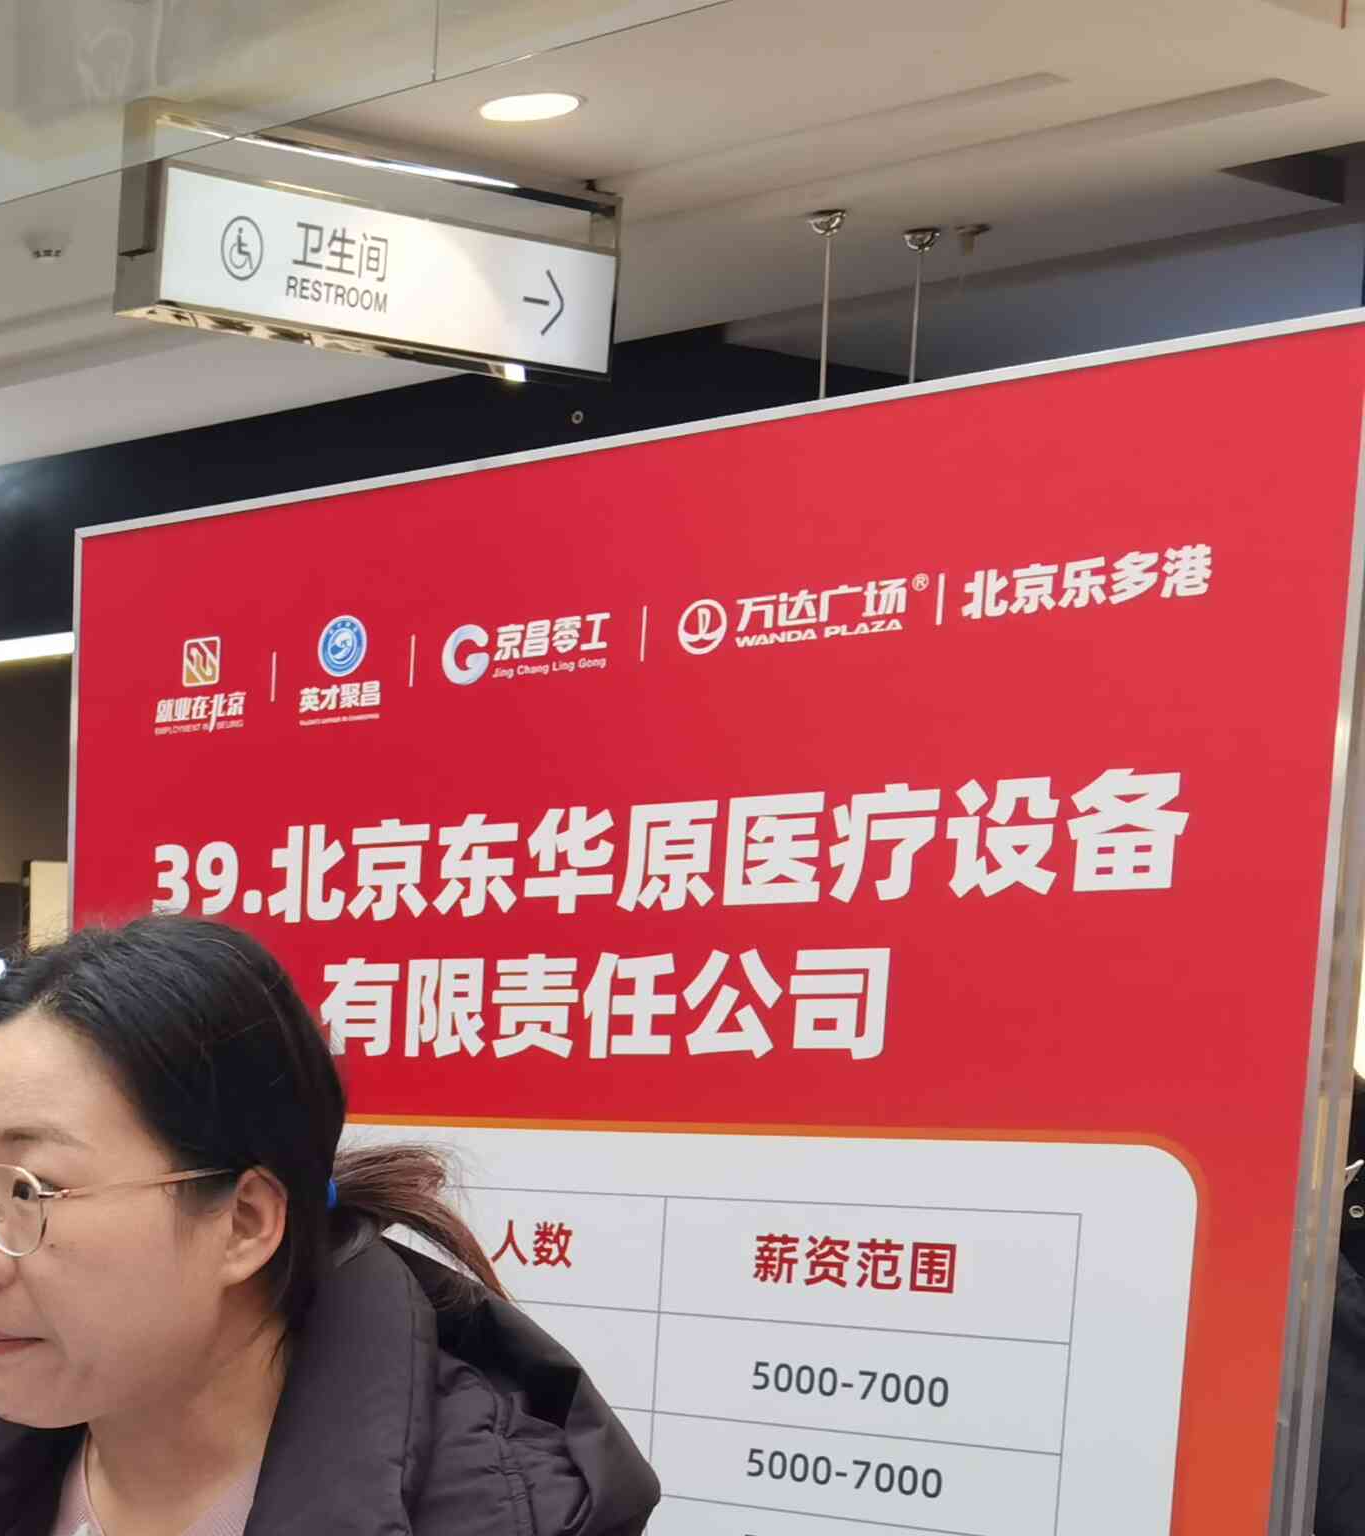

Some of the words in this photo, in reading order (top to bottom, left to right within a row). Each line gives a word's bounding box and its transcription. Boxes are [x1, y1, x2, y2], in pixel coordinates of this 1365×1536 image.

[292, 221, 388, 283] 卫生间
[285, 276, 388, 313] RESTROOM
[961, 543, 1212, 620] 北京乐多港
[492, 612, 611, 661] 京昌零工
[735, 628, 818, 648] WANDA
[824, 617, 904, 638] PLAZA
[299, 680, 381, 713] 英才聚昌
[151, 768, 1188, 924] 39.北京东华原医疗设备
[319, 946, 891, 1061] 有限责任公司
[752, 1232, 958, 1295] 薪资范围
[751, 1360, 950, 1408] 5000-7000
[745, 1447, 944, 1499] 5000-7000
